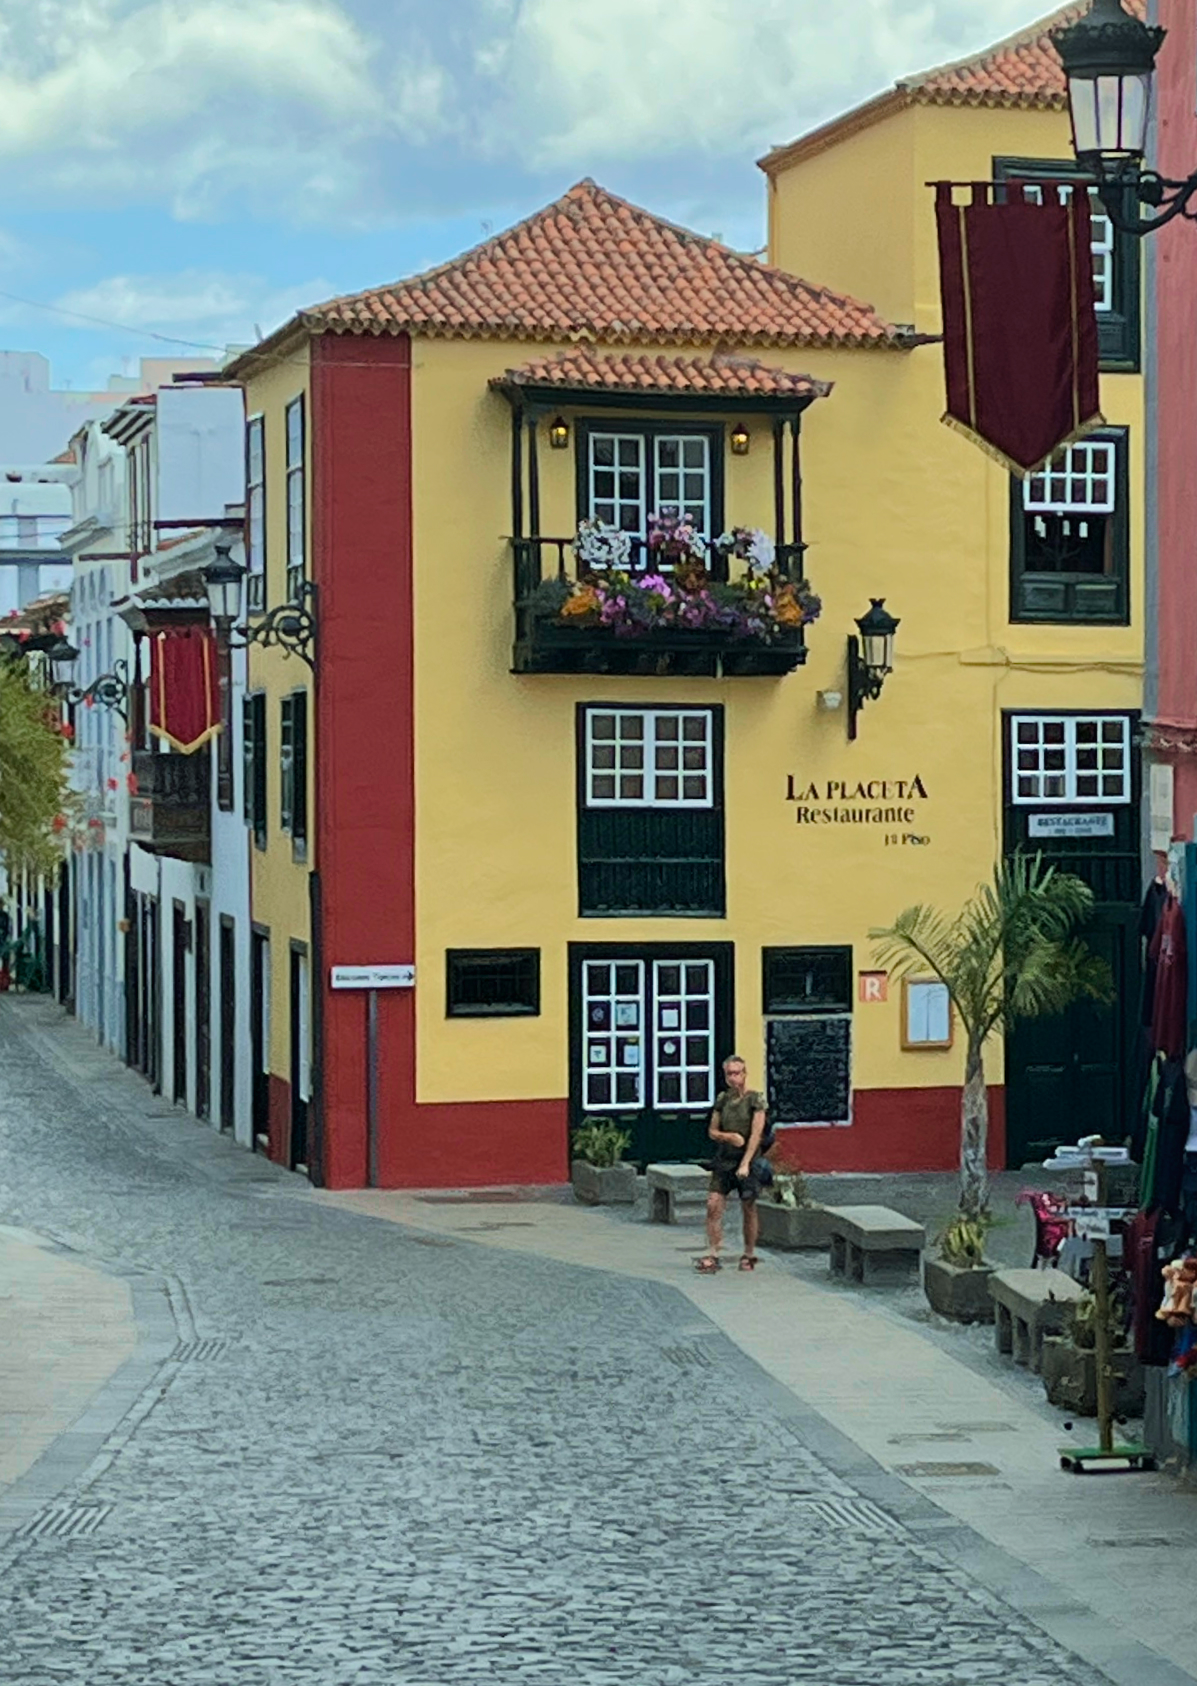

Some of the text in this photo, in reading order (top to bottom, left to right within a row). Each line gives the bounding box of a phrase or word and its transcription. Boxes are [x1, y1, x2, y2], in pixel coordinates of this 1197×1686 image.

[785, 773, 928, 801] LA PLACETA
[796, 806, 915, 824] Restaurante
[865, 976, 882, 1000] R
